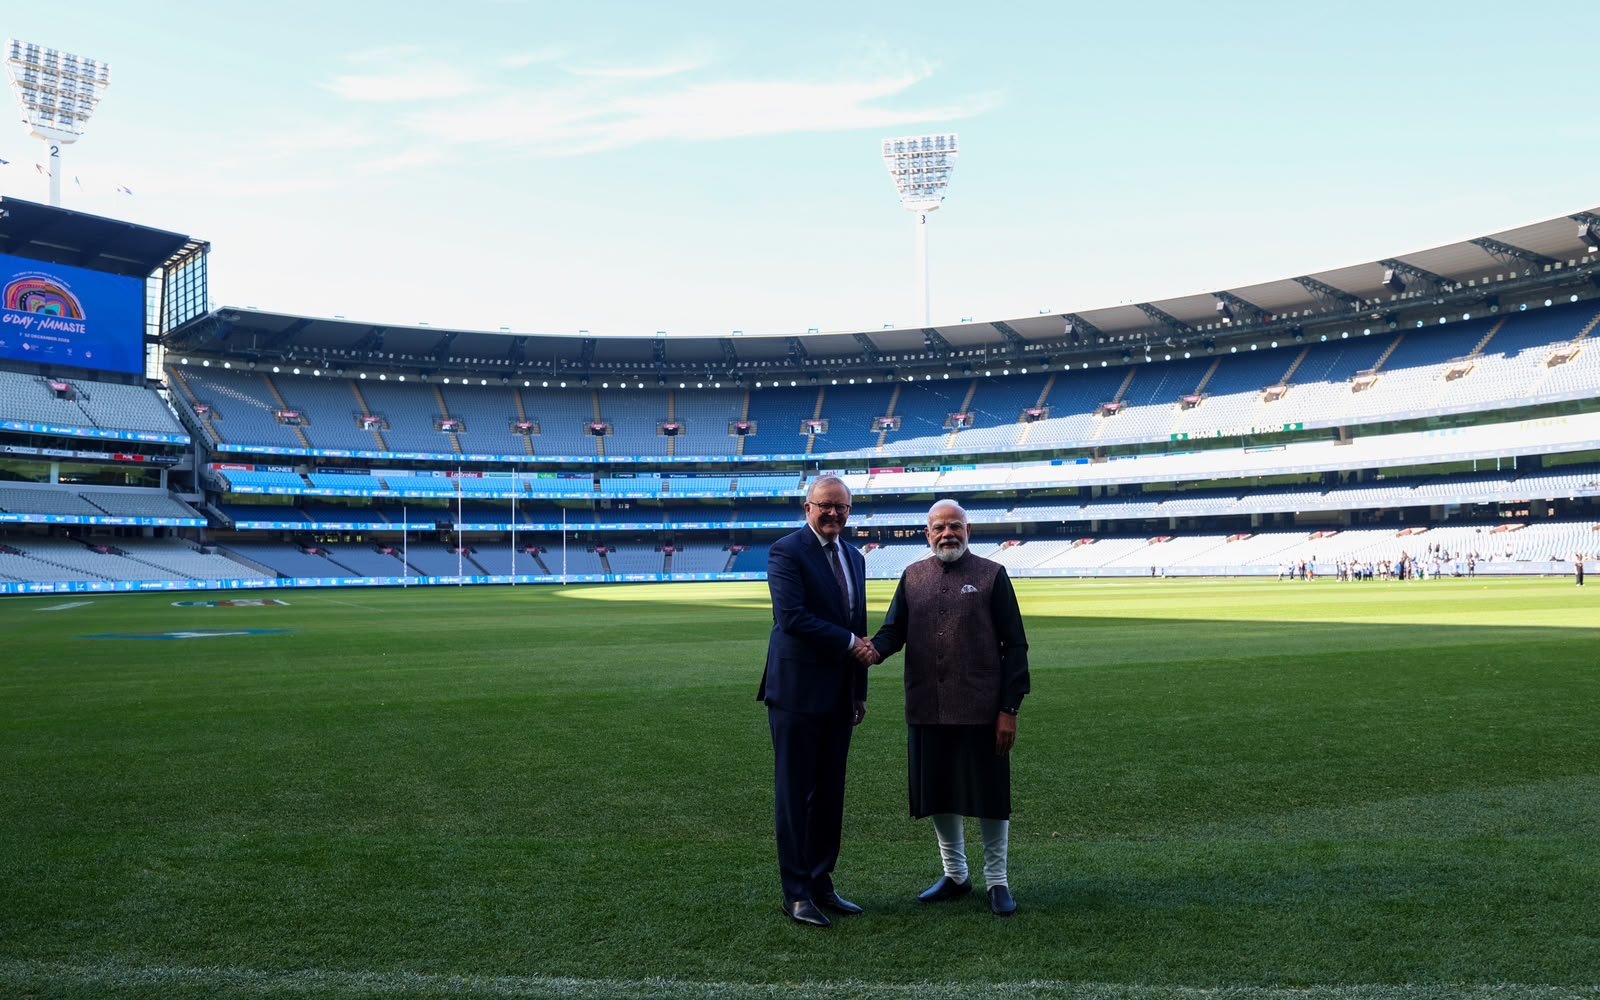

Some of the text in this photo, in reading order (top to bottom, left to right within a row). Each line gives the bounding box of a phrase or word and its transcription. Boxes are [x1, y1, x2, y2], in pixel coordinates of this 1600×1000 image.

[50, 145, 59, 157] 2
[920, 214, 926, 224] 3
[2, 313, 34, 329] G'DAY
[37, 317, 86, 334] NAMASTE
